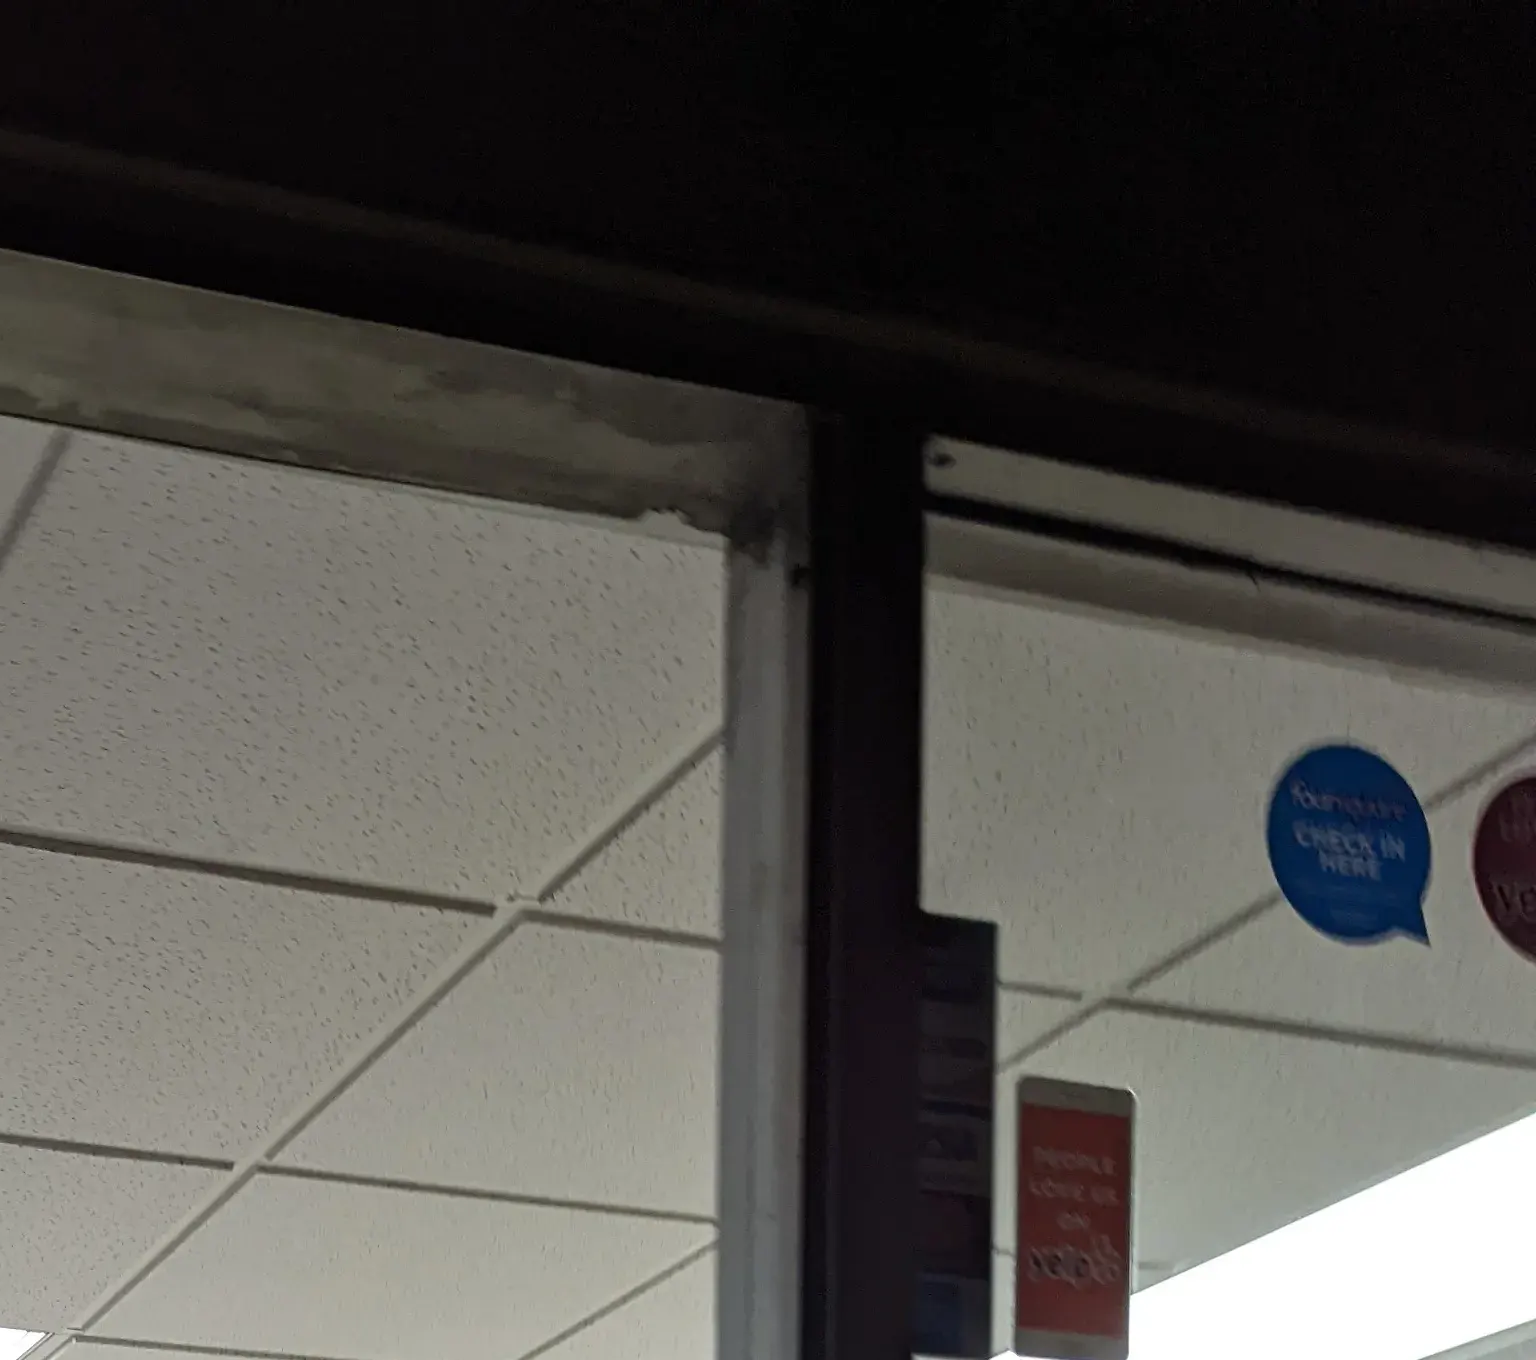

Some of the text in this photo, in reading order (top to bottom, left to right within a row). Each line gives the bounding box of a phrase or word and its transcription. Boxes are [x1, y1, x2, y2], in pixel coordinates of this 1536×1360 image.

[1292, 820, 1406, 862] CHECK IN
[1318, 849, 1383, 881] HERE
